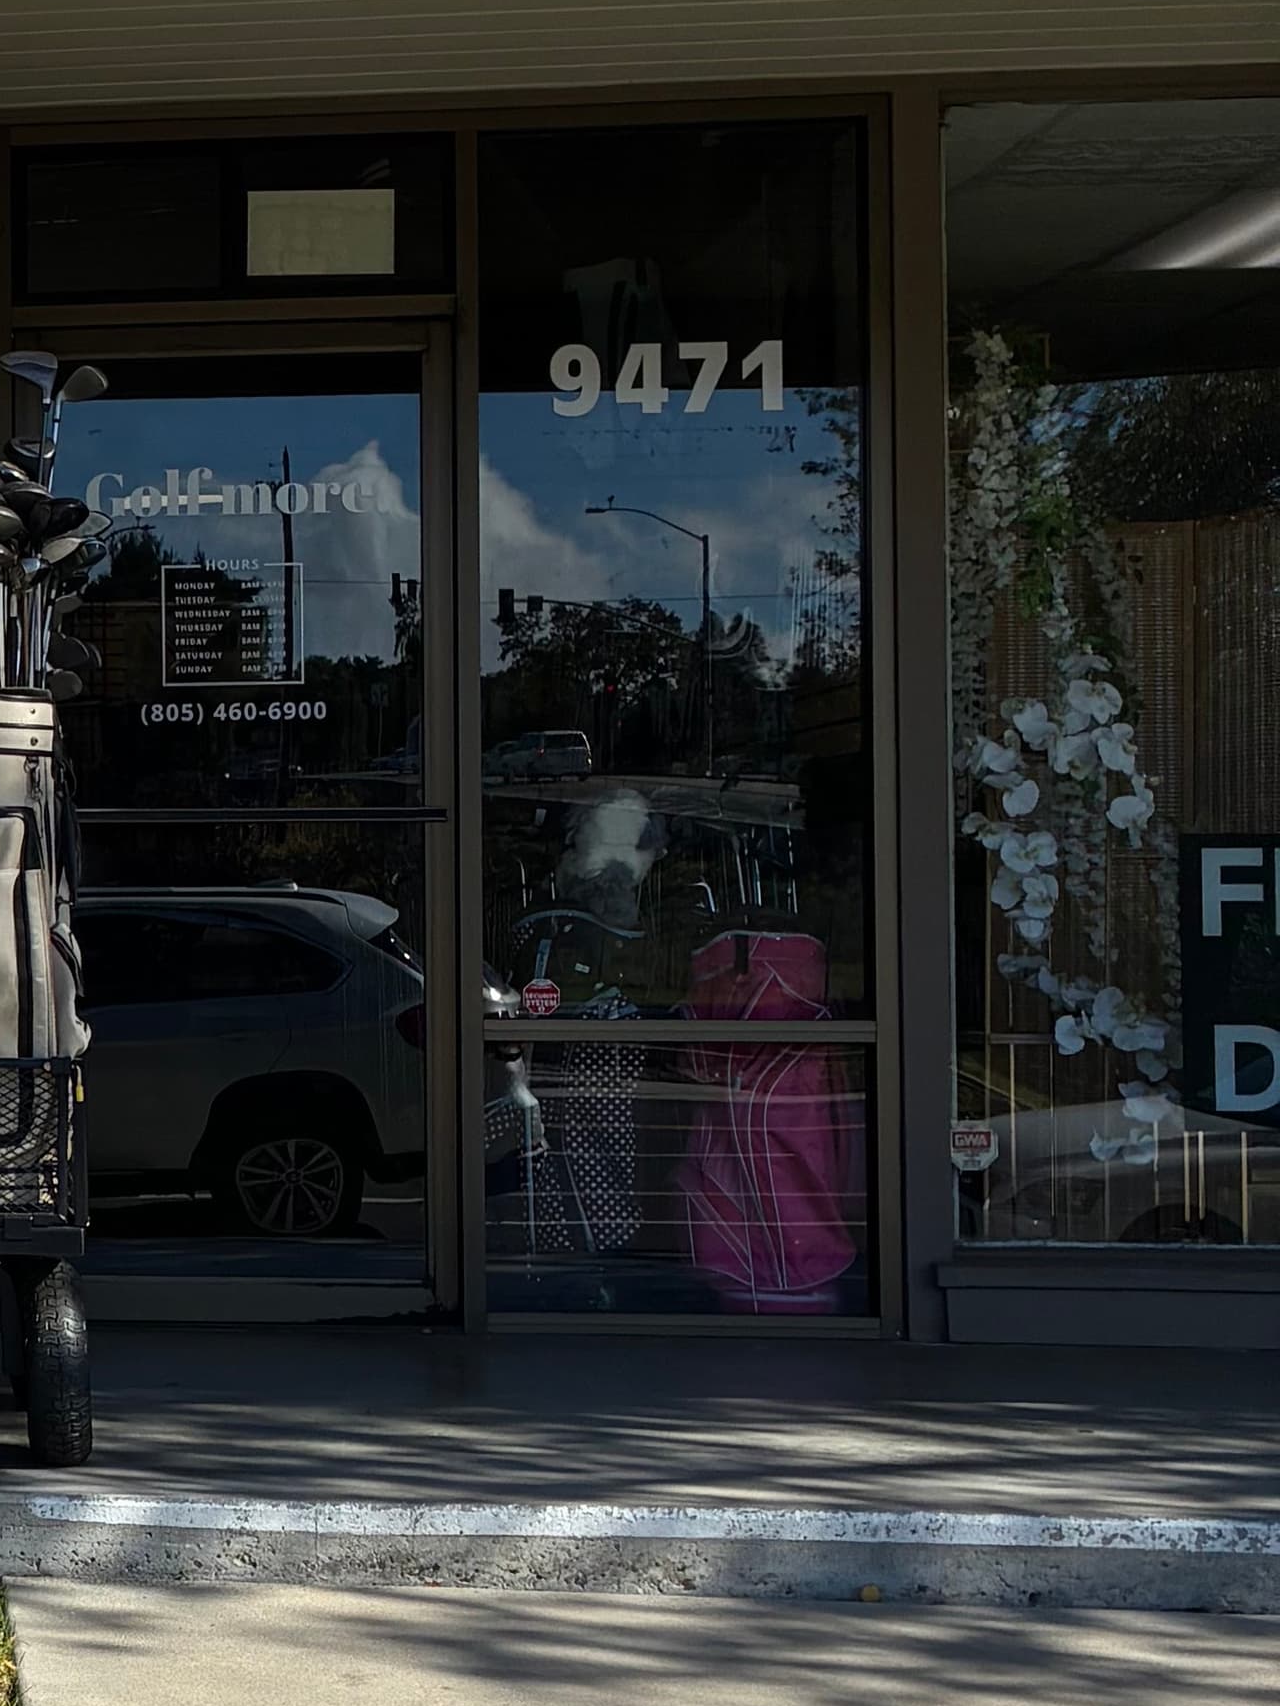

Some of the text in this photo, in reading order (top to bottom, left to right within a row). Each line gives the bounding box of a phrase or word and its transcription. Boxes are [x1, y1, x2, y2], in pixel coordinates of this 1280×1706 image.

[549, 339, 785, 418] 9471
[86, 467, 214, 517] Golf
[205, 559, 260, 572] HOURS
[174, 582, 216, 590] MONDAY
[175, 596, 216, 605] TUESDAY
[174, 609, 231, 619] WEDNESDAY
[175, 623, 224, 632] THURSDAY
[175, 637, 208, 646] FRIDAY
[175, 651, 223, 660] SATURDAY
[175, 665, 214, 674] SUNDAY
[140, 700, 328, 726] (805) 460-6900
[1200, 847, 1280, 937] F
[954, 1133, 989, 1147] GWA
